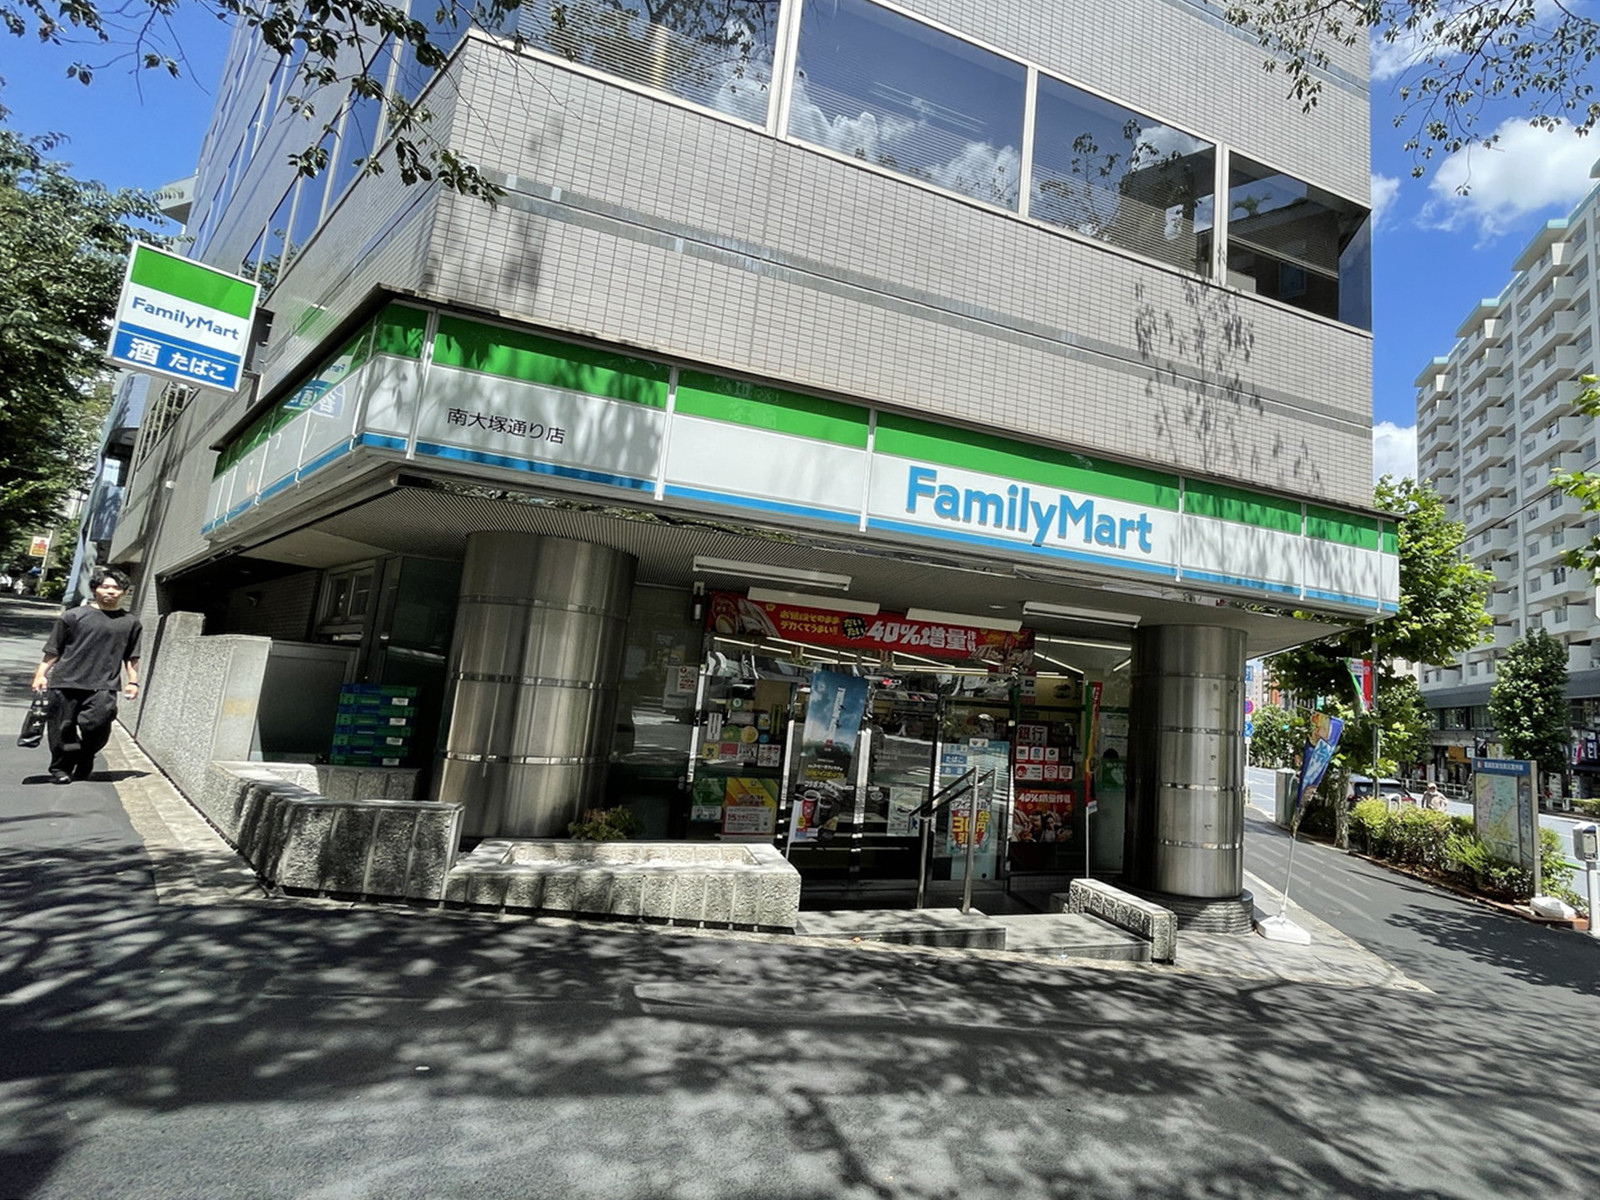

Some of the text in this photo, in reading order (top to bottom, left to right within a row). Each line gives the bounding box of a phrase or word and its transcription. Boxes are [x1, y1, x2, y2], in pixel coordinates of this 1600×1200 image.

[132, 296, 239, 340] FamilyMart
[127, 337, 227, 381] 酒 たばこ
[447, 407, 566, 444] 南大塚通り店
[905, 465, 1152, 554] FamilyMart
[1017, 725, 1045, 741] 銀行
